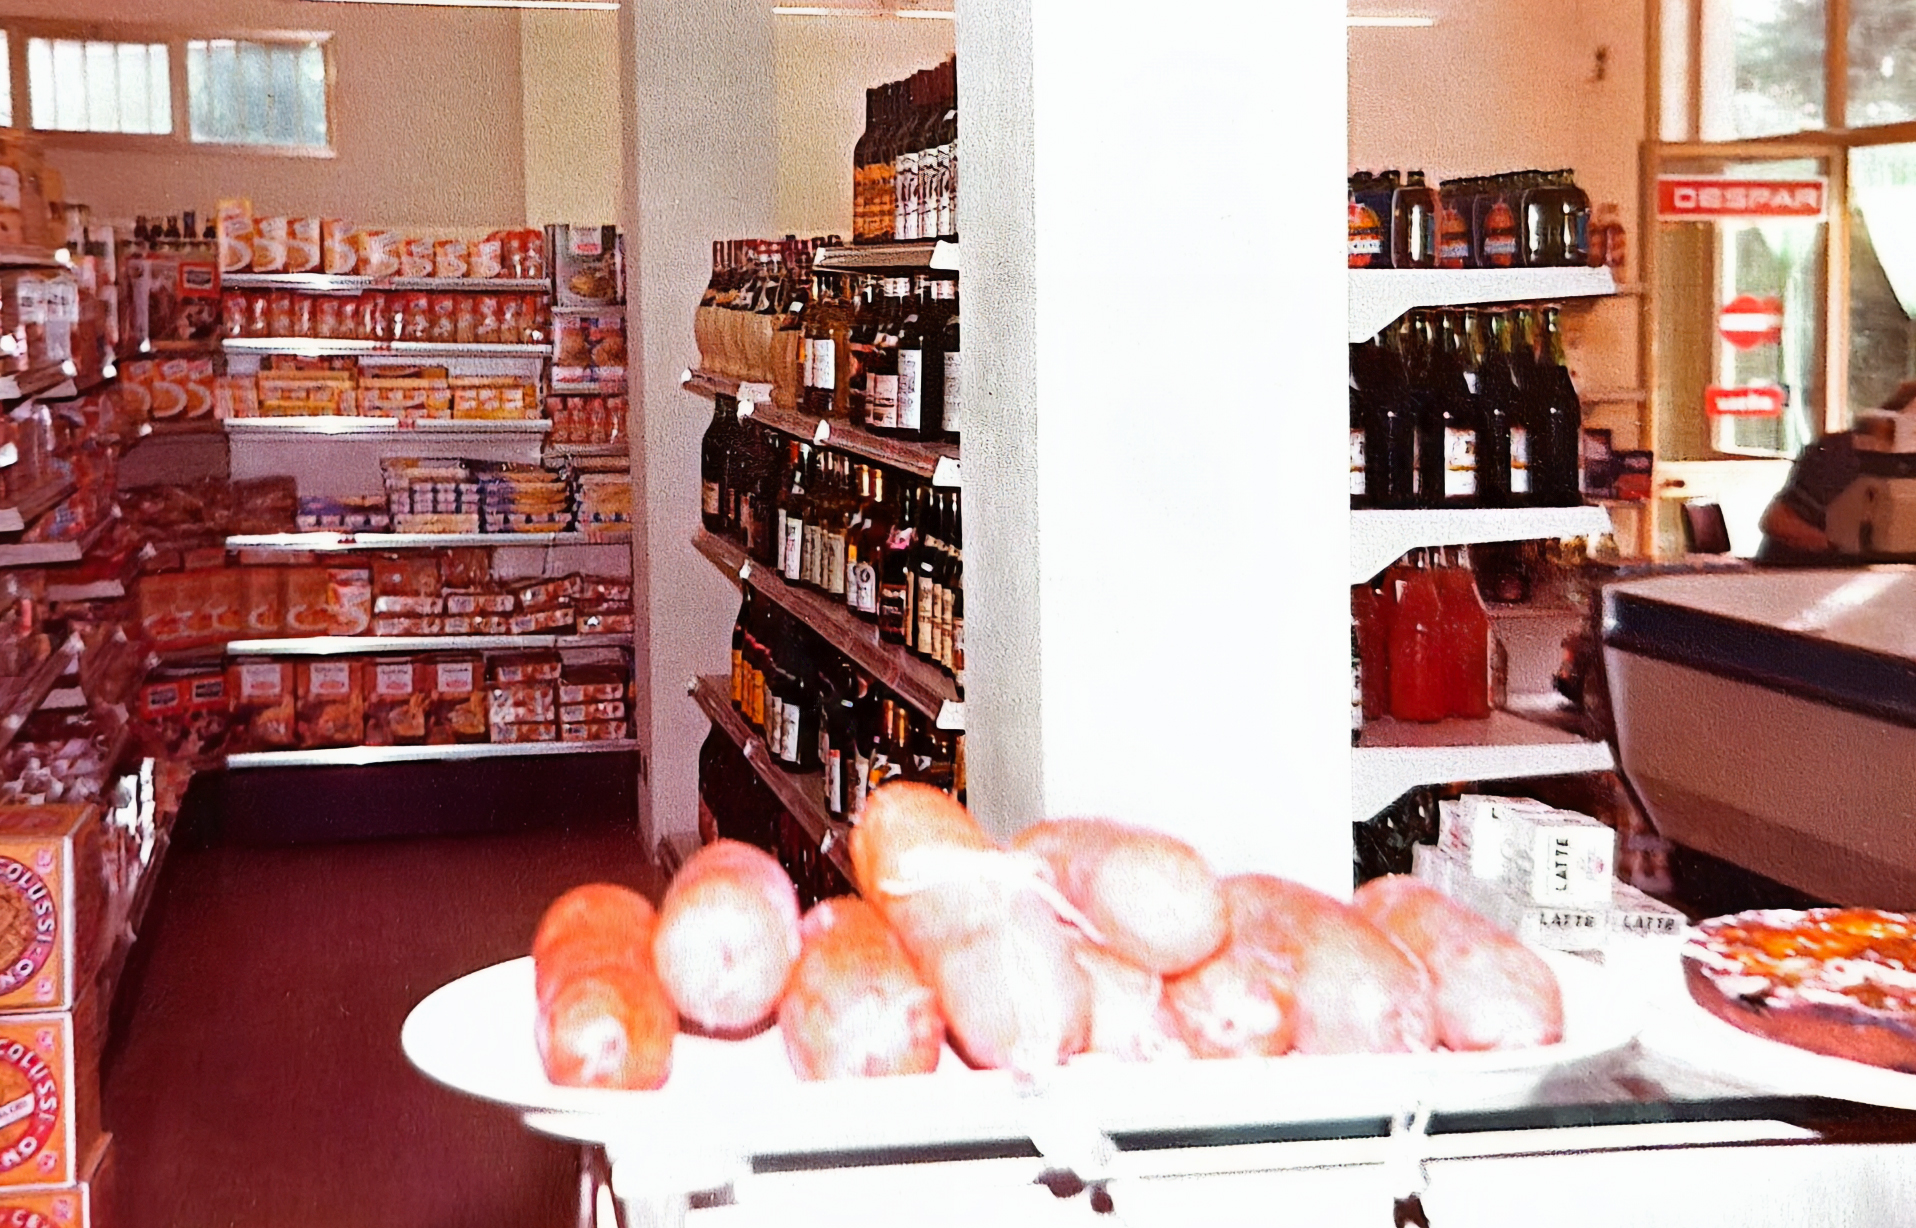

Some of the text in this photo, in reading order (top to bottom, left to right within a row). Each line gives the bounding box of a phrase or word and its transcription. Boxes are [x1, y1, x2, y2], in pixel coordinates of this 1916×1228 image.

[1673, 187, 1818, 210] DESPAR
[1554, 838, 1570, 892] LATTE
[1539, 912, 1595, 927] LATTE
